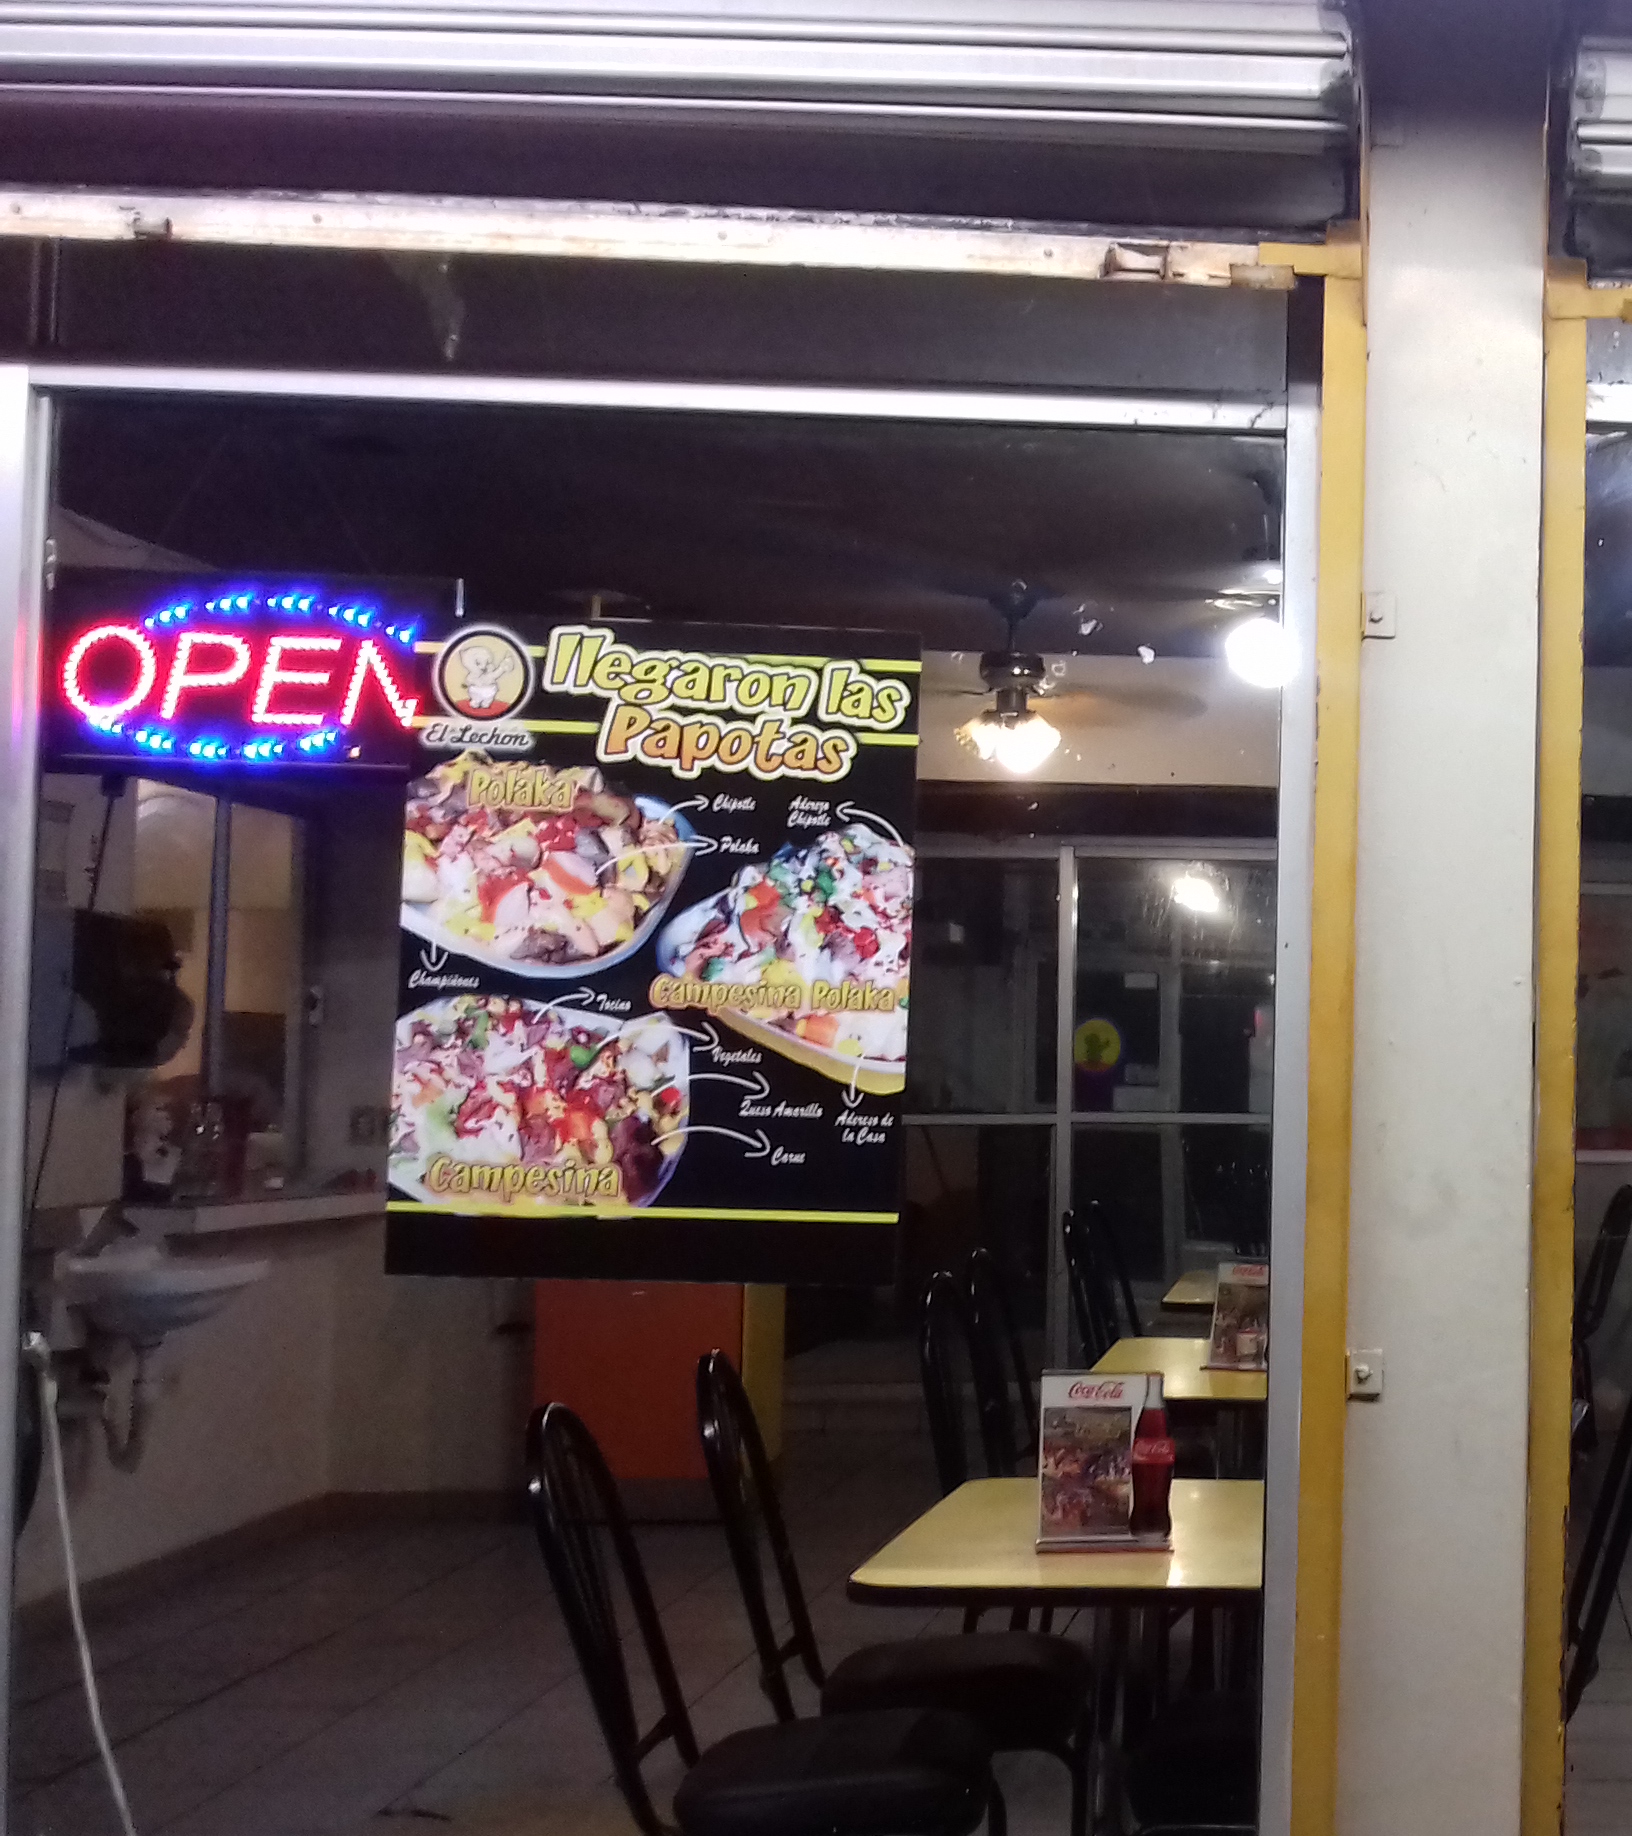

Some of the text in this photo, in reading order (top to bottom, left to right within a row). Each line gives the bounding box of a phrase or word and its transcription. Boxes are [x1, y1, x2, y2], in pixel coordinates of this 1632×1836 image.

[63, 624, 419, 728] OPEN
[548, 630, 905, 724] llegaron las
[425, 722, 449, 743] El
[602, 702, 853, 776] Papotas
[467, 767, 574, 808] Polaka
[711, 793, 756, 814] Chipotle
[787, 810, 832, 829] Chipotle
[719, 836, 760, 855] Polaka
[596, 994, 632, 1012] Tocino
[652, 977, 896, 1013] Campesina Polaka
[711, 1048, 762, 1067] Vegetales
[738, 1099, 824, 1118] Queso Amarillo
[880, 1111, 895, 1127] de
[842, 1127, 886, 1145] la Casa
[770, 1147, 806, 1166] Carne
[428, 1155, 620, 1203] Campesina
